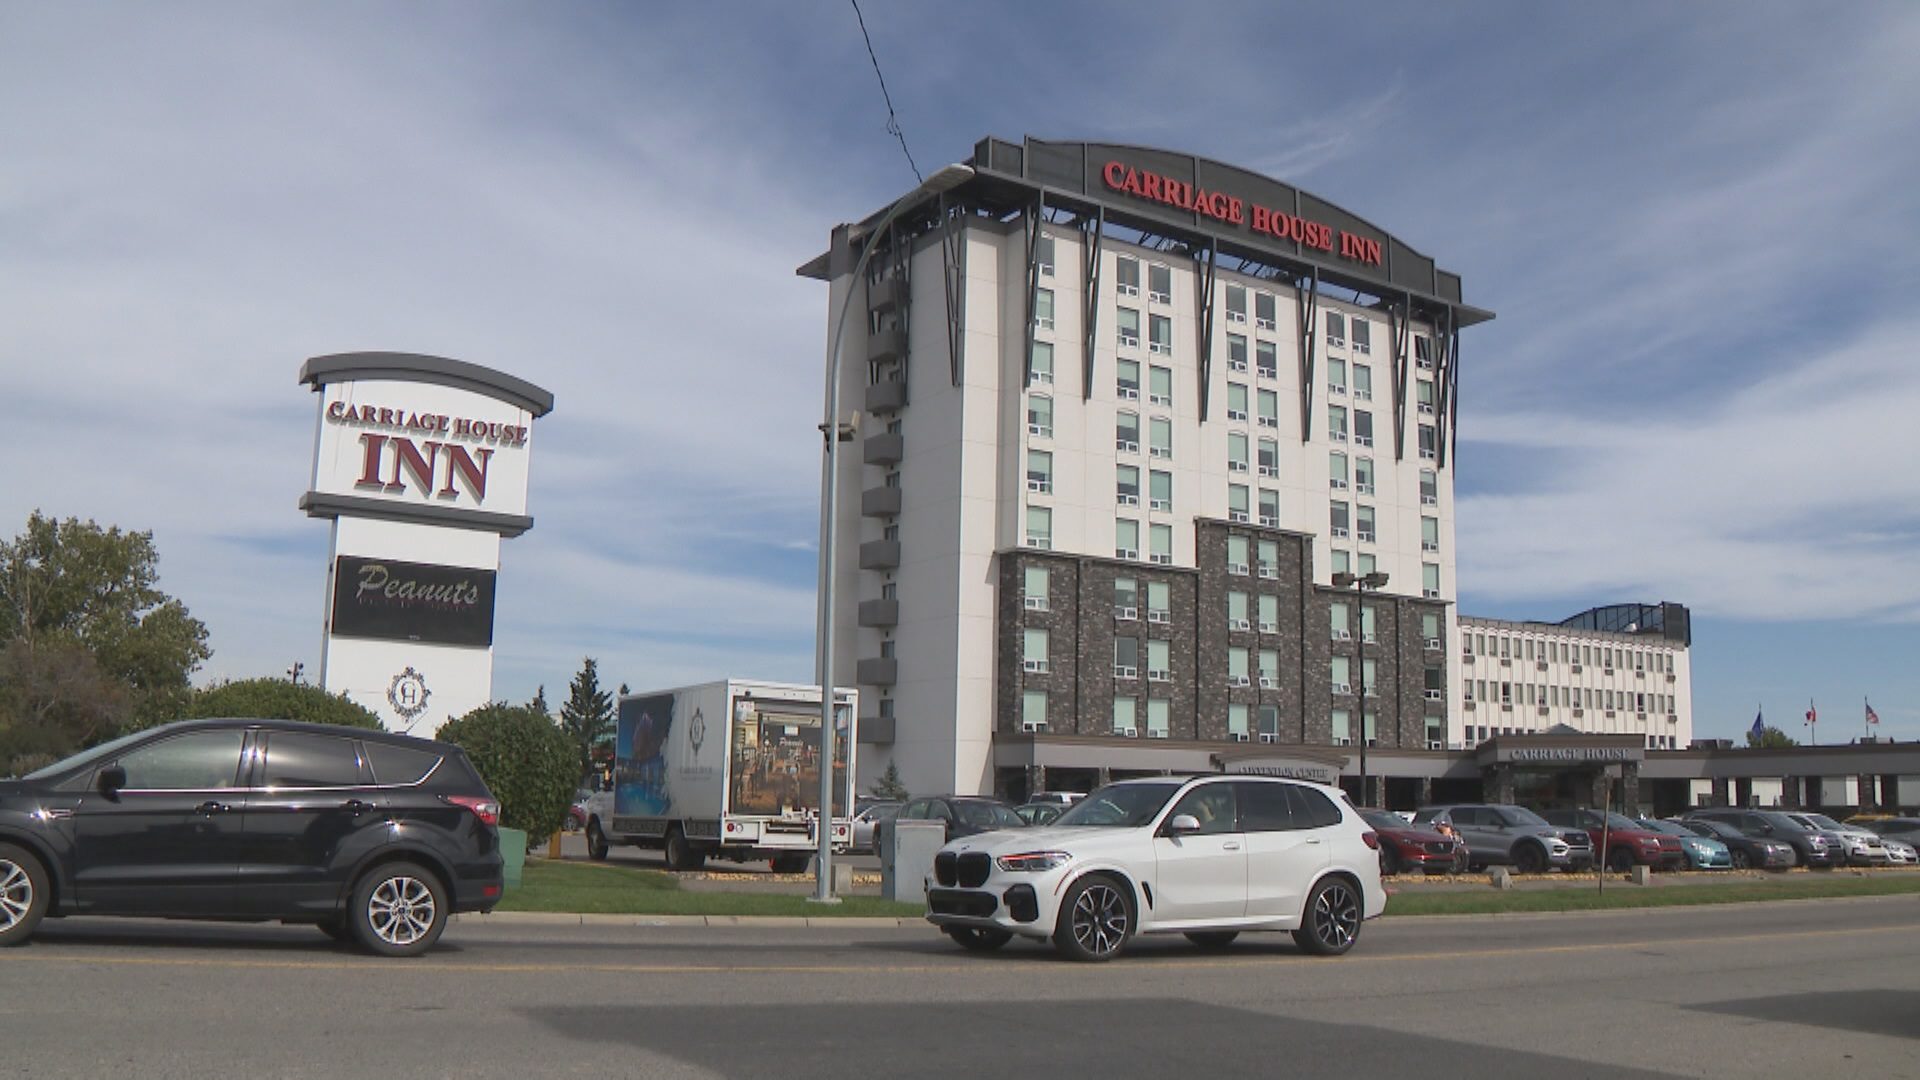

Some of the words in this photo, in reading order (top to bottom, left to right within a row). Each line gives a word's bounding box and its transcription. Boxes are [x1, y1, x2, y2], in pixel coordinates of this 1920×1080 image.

[1103, 160, 1244, 225] CARRIAGE
[1252, 204, 1334, 250] HOUSE
[1340, 230, 1382, 266] INN
[326, 401, 449, 434] CARRIAGE
[455, 416, 528, 445] HOUSE
[355, 432, 494, 503] INN
[356, 565, 478, 604] Peanuts
[1239, 766, 1294, 779] CONVENTION
[1511, 748, 1577, 761] CARRIAGE
[1586, 748, 1630, 760] HOUSE
